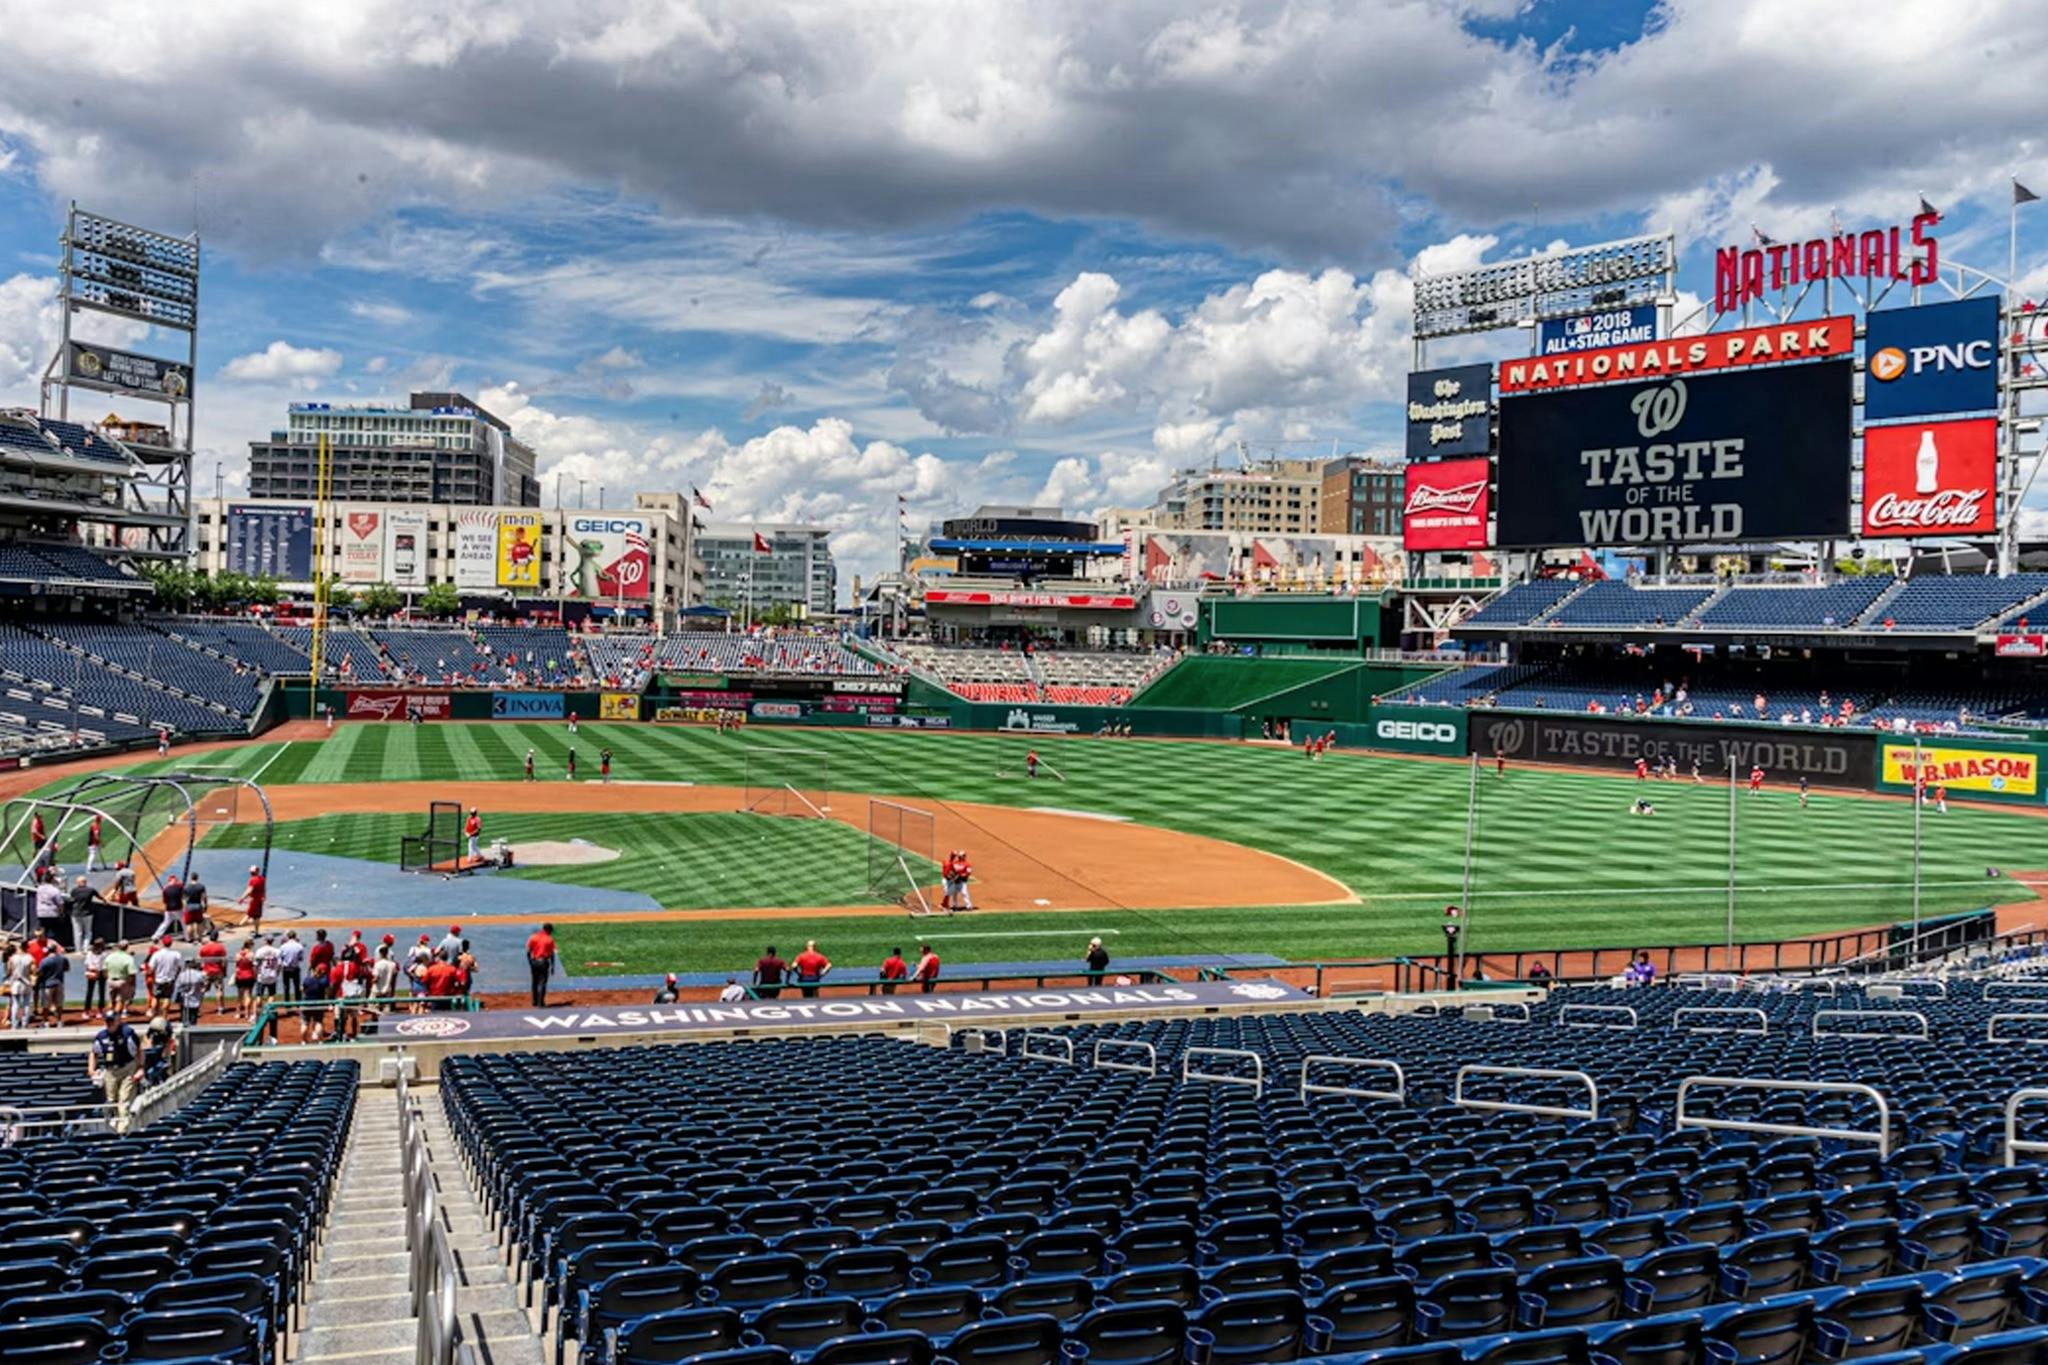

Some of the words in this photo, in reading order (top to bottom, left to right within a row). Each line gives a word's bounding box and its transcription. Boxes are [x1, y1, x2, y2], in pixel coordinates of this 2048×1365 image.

[1715, 212, 1939, 313] NATIONALS
[1593, 311, 1631, 331] 2018
[1611, 325, 1653, 345] GAME
[1509, 342, 1706, 385] NATIONALS
[1727, 326, 1830, 358] PARK
[1910, 341, 1992, 373] PNC
[1434, 379, 1461, 398] The
[1408, 399, 1487, 420] Washington
[1430, 422, 1463, 445] Post
[1581, 438, 1744, 486] TASTE
[1411, 490, 1477, 507] Budweiser
[1625, 487, 1650, 504] OF
[1656, 484, 1694, 502] THE
[1868, 488, 1988, 527] Coca-Cola
[574, 519, 643, 533] GEICO
[1579, 503, 1743, 543] WORLD
[347, 552, 378, 560] TODAY
[460, 552, 493, 560] AHEAD
[870, 682, 902, 693] FAN
[511, 699, 562, 712] INOVA
[1377, 720, 1456, 742] GEICO
[1544, 728, 1640, 758] TASTE
[1643, 740, 1669, 759] OF
[1676, 742, 1715, 763] THE
[1719, 739, 1848, 774] WORLD
[1901, 758, 2030, 781] WB.MASON
[523, 1000, 904, 1030] WASHINGTON
[915, 987, 1197, 1012] NATIONALS
